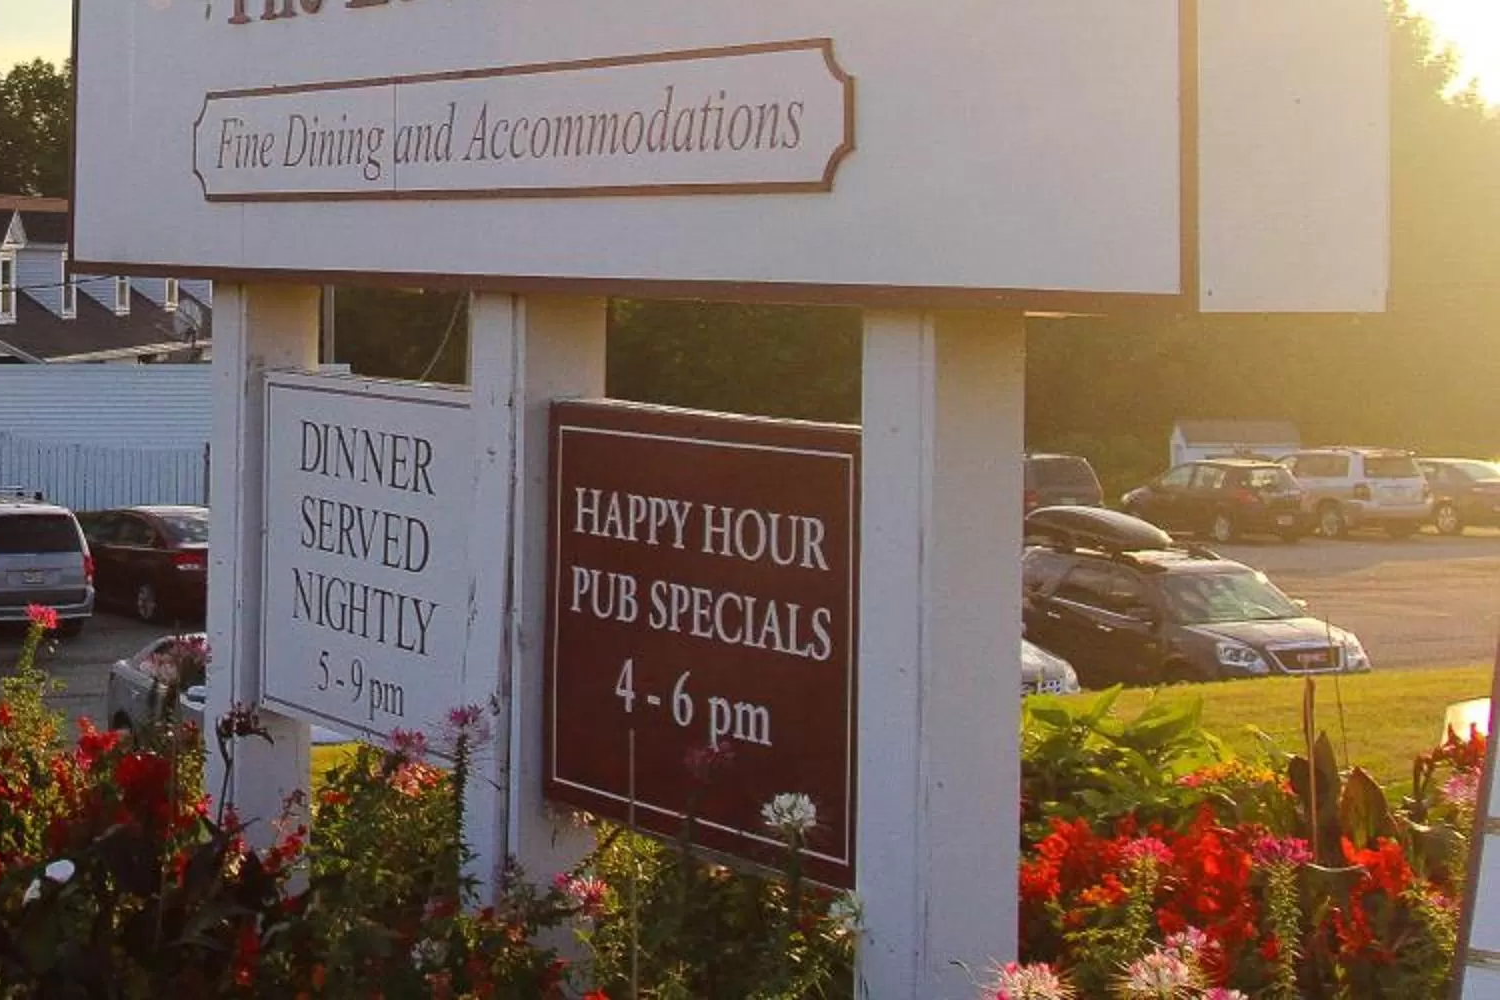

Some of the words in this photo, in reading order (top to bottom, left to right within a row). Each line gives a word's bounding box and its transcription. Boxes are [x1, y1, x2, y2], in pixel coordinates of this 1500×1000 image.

[216, 117, 276, 169] Fine
[283, 113, 385, 181] Dining
[394, 101, 456, 164] and
[462, 85, 804, 161] Accommodations
[300, 419, 436, 496] DINNER
[300, 495, 430, 573] SERVED
[573, 487, 693, 549] HAPPY
[701, 504, 830, 571] HOUR
[292, 567, 440, 656] NIGHTLY
[570, 566, 639, 623] PUB
[649, 580, 832, 661] SPECIALS
[369, 677, 405, 721] pm
[707, 695, 773, 752] pm
